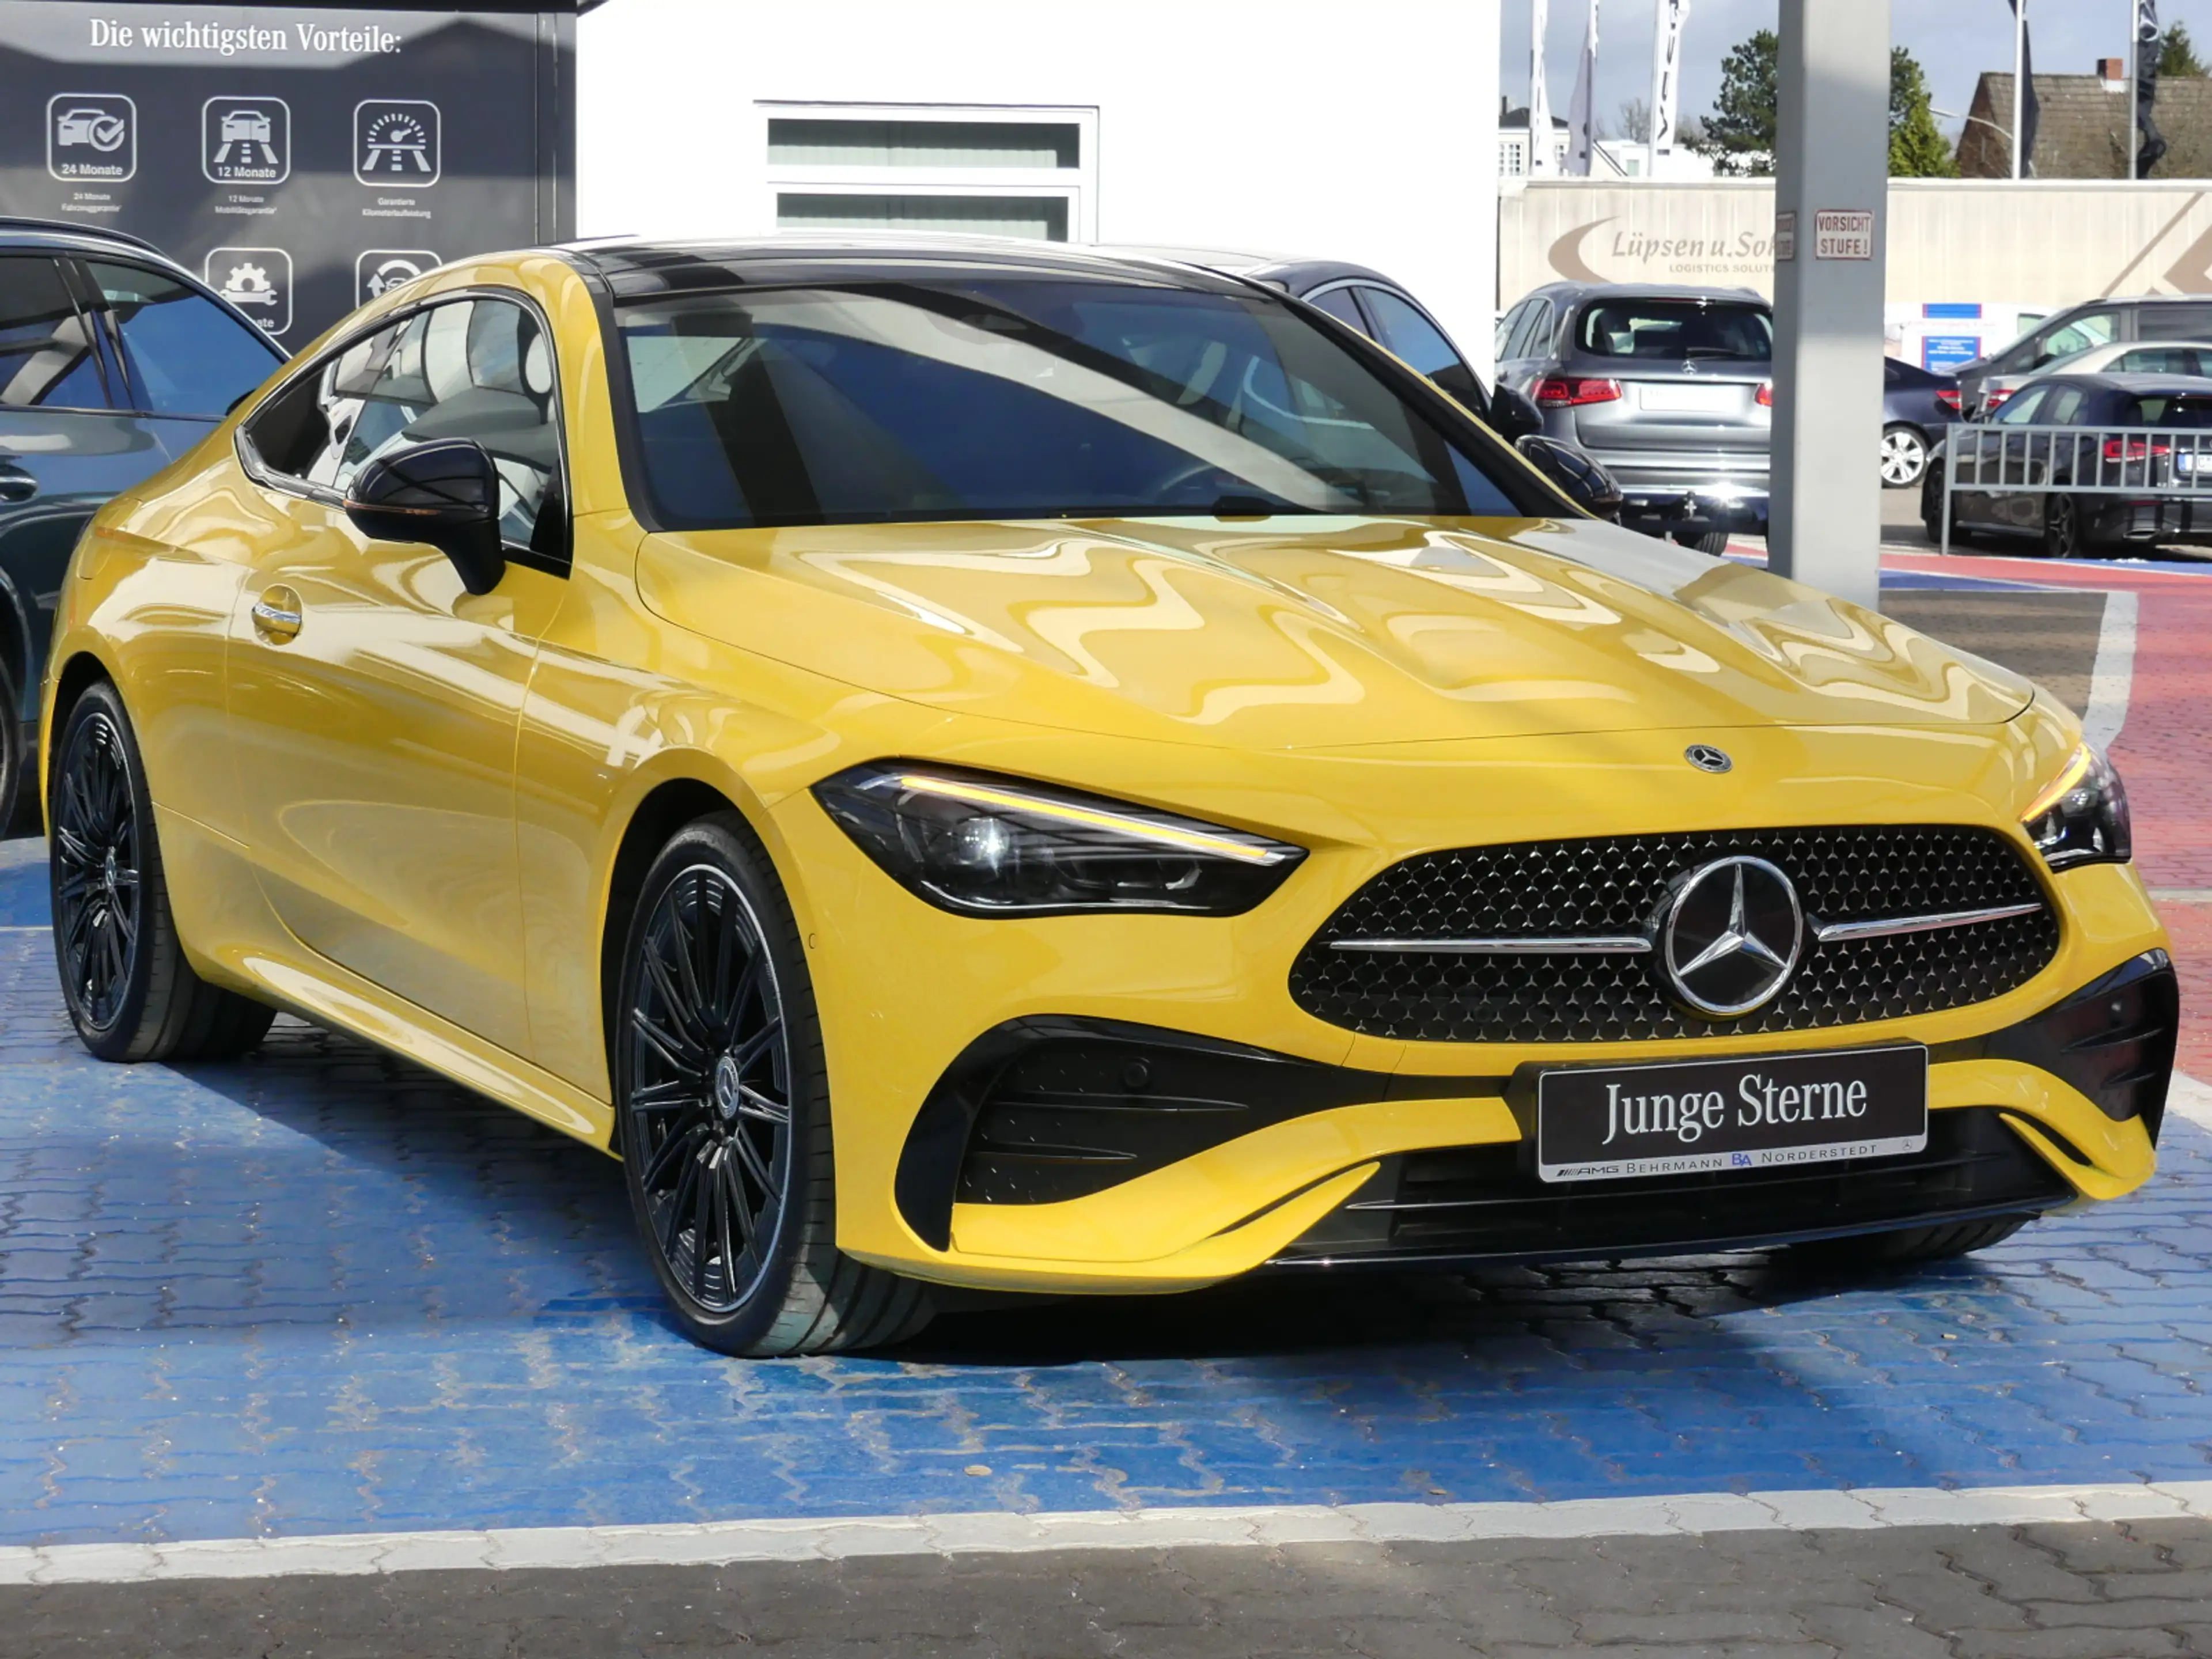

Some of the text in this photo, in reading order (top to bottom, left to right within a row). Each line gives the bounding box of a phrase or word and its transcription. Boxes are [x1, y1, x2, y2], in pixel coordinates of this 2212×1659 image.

[89, 18, 402, 56] Die wichtigsten Vorteile:
[61, 164, 123, 176] 24 Monate
[217, 166, 276, 178] 12 Monate
[1818, 215, 1871, 232] VORSICHT
[1612, 231, 1704, 265] Lüpsen
[1820, 238, 1868, 255] STUFE!
[1669, 263, 1729, 273] LOGISTICS
[1602, 1074, 1868, 1145] Junge Sterne
[1627, 1158, 1723, 1173] BEHRMANN
[1761, 1145, 1877, 1163] NORDERSTEDT
